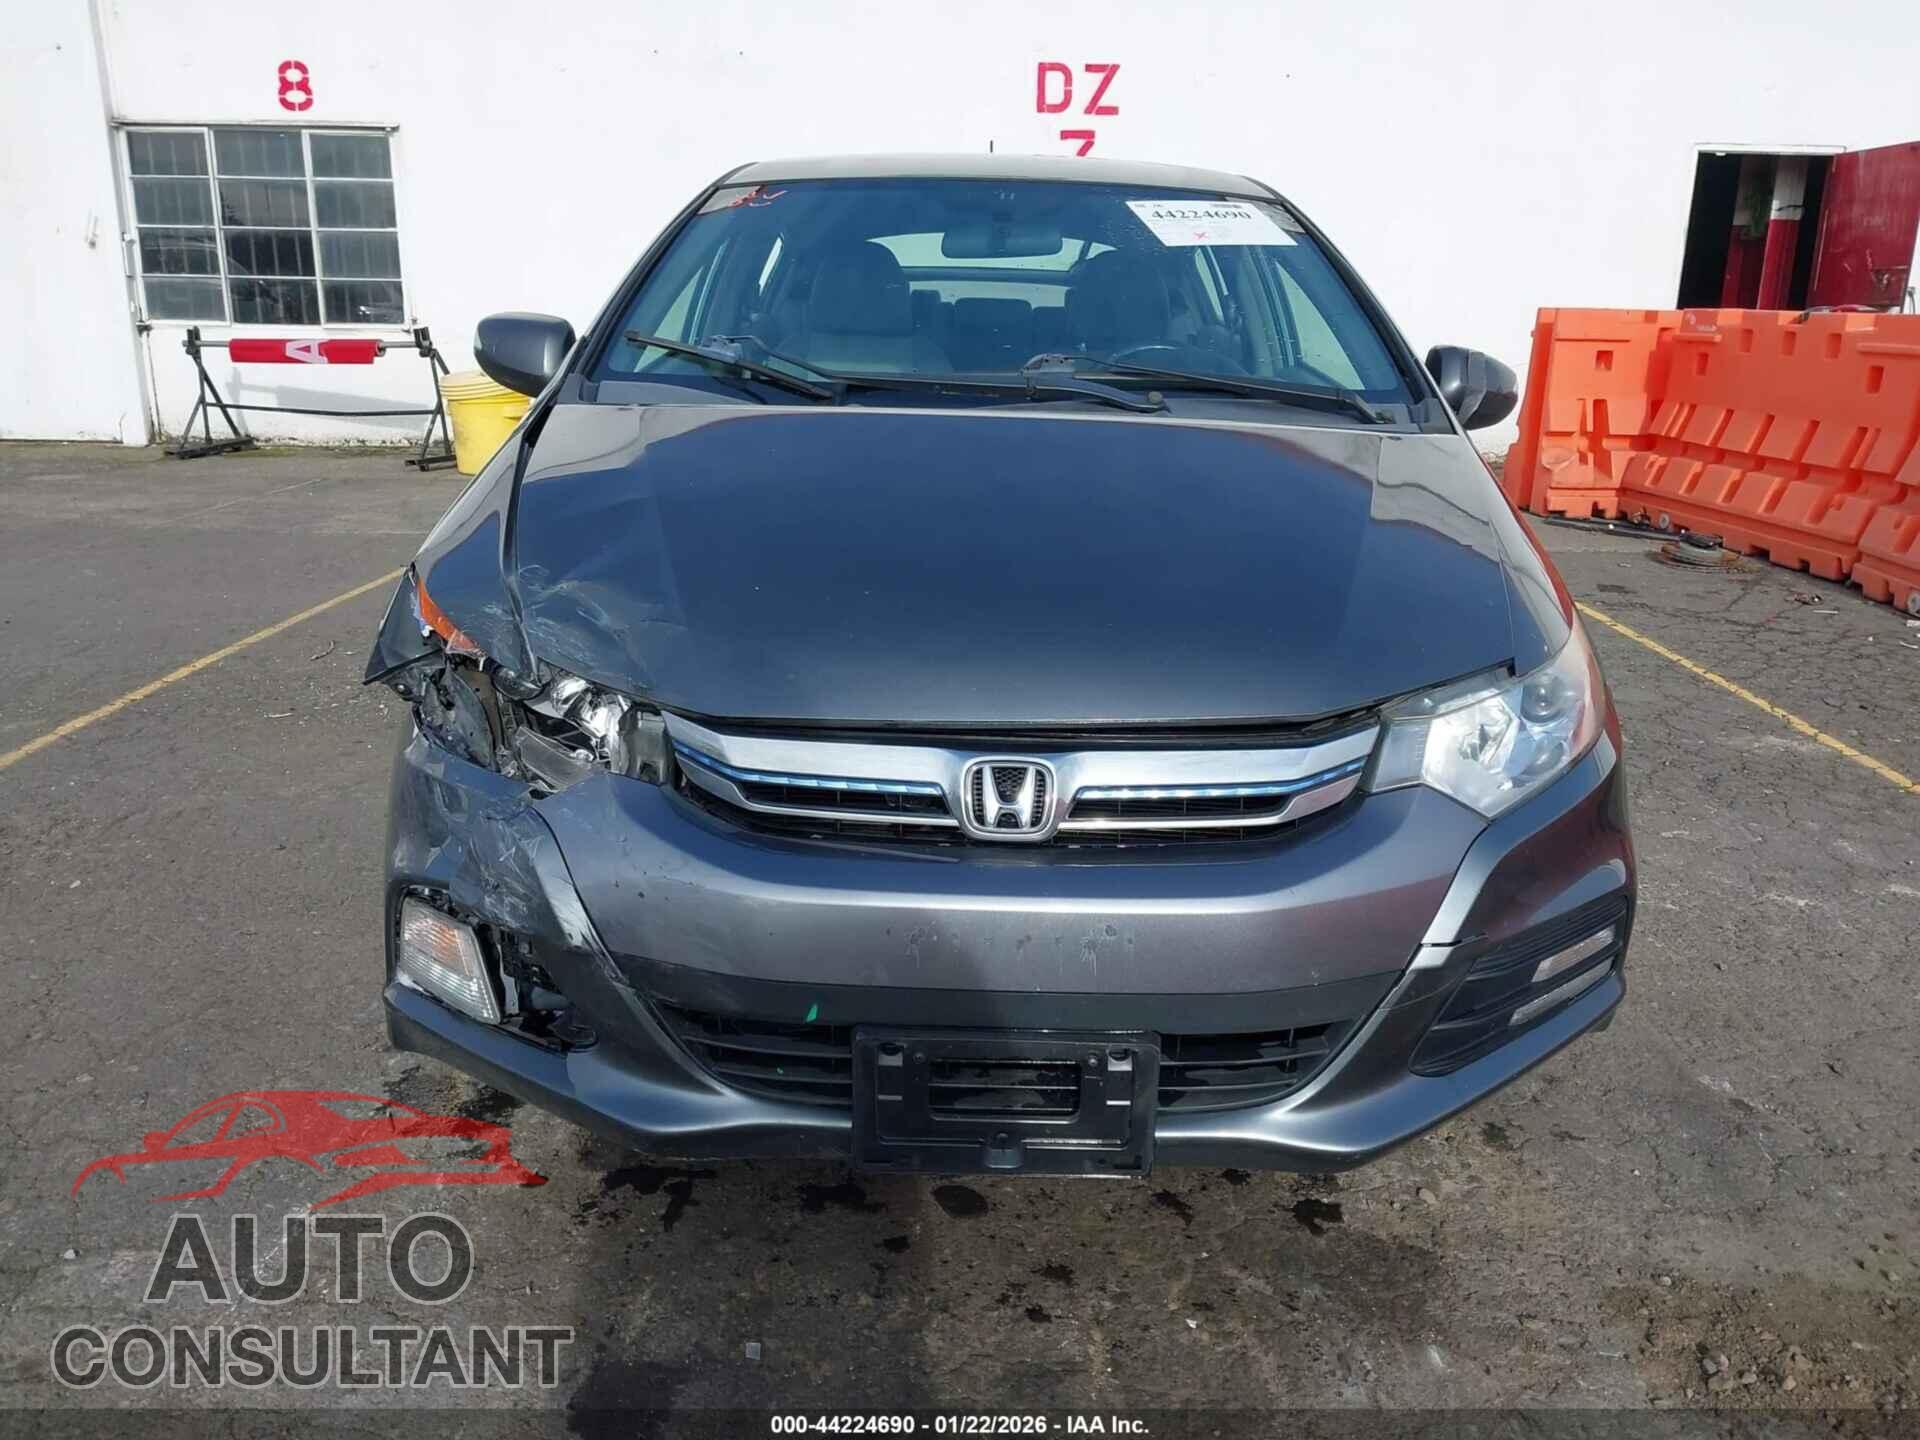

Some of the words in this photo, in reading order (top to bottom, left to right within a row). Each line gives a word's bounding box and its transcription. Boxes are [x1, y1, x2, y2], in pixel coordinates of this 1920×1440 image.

[277, 60, 314, 112] 8
[1036, 62, 1120, 116] DZ
[1151, 207, 1252, 219] 44224690
